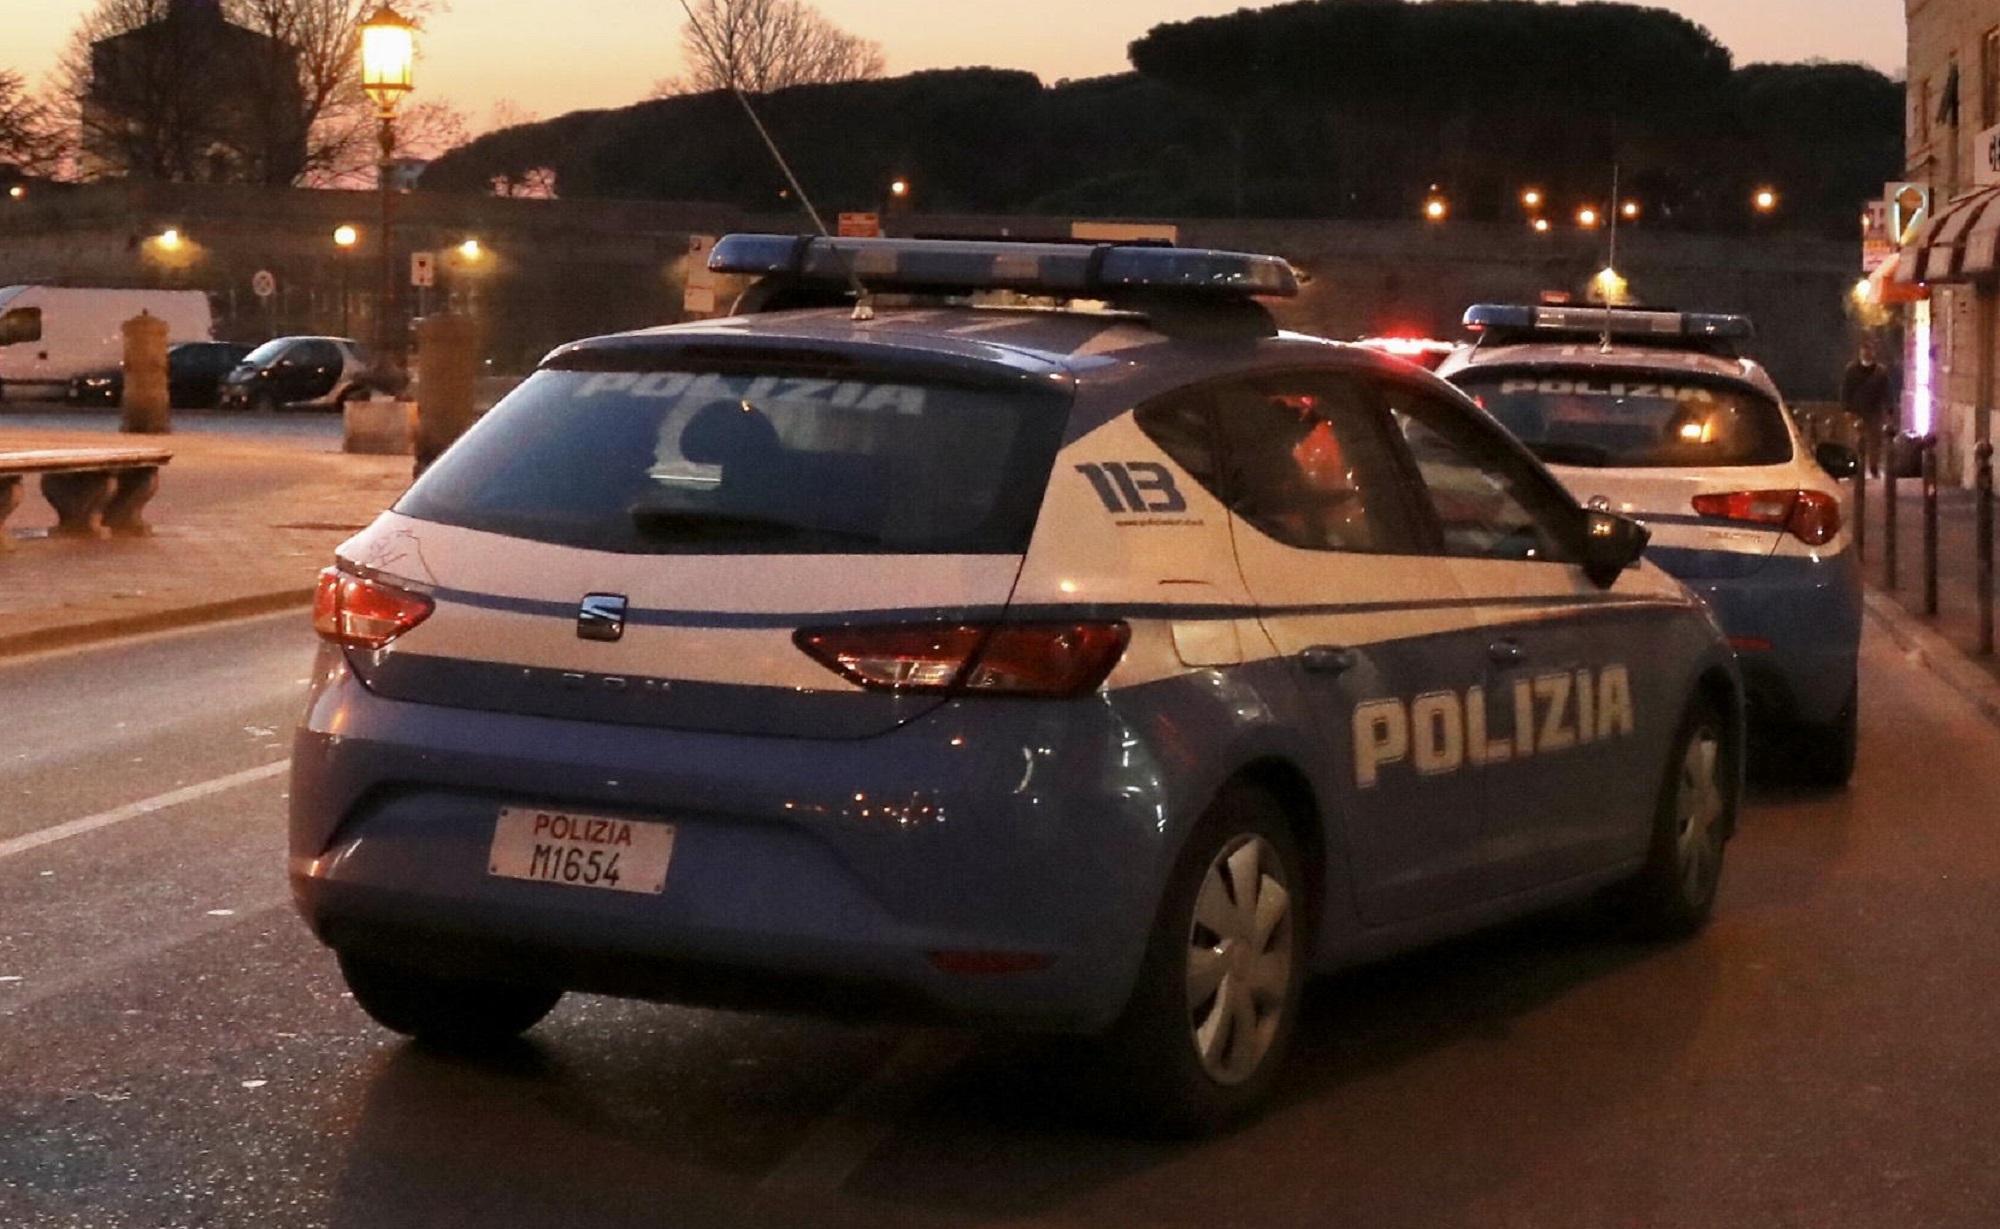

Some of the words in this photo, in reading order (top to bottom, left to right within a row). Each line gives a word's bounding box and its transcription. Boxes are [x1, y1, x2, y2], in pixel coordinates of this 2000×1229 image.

[573, 371, 926, 414] POLIZIA
[1074, 462, 1187, 513] 113
[1353, 664, 1634, 788] POLIZIA
[533, 814, 632, 846] POLIZIA
[530, 844, 620, 886] M1654
